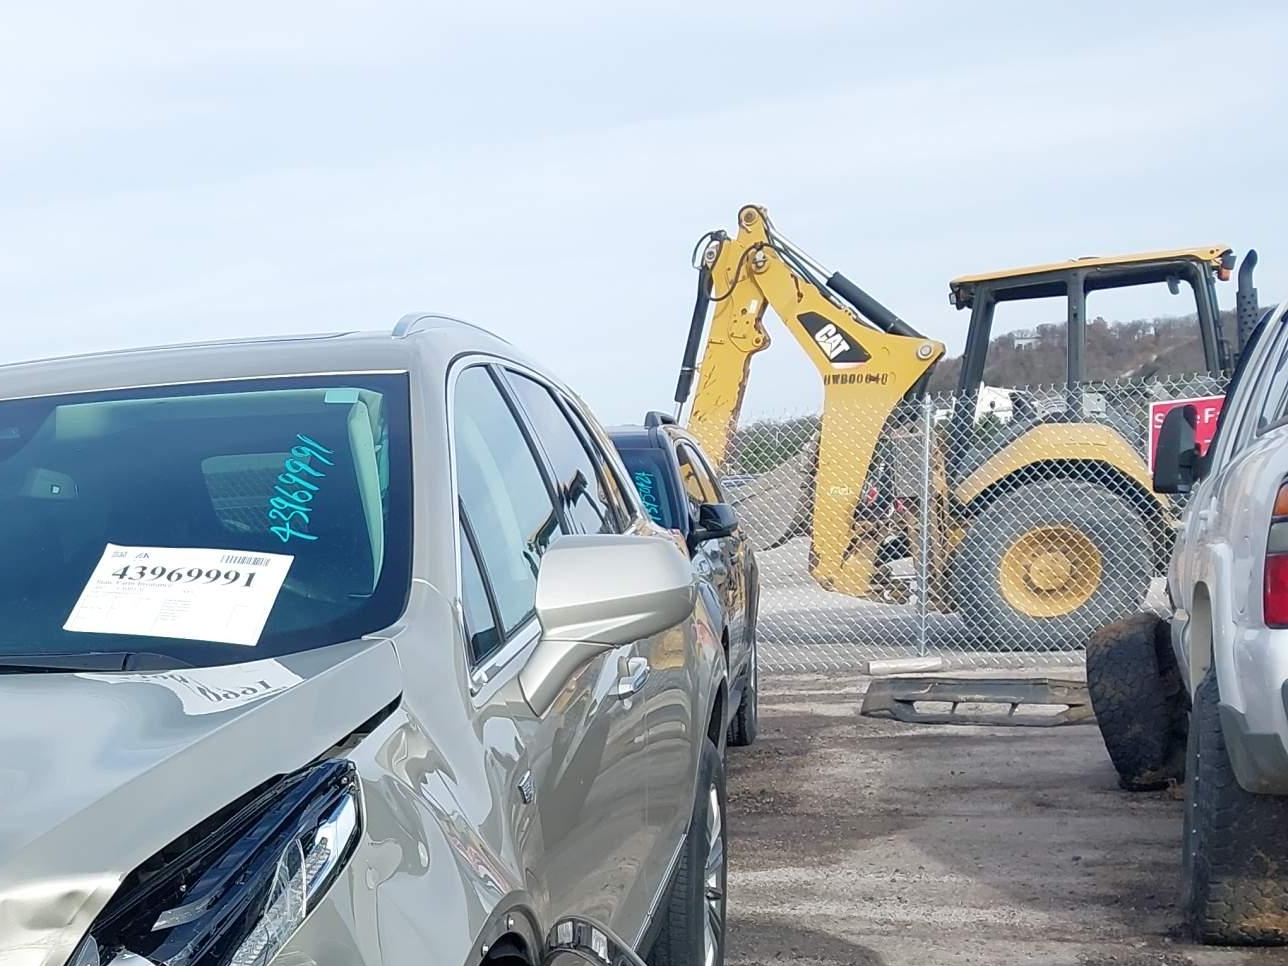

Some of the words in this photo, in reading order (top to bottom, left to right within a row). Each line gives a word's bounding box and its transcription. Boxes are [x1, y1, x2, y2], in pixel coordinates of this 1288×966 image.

[815, 323, 850, 360] CAT
[268, 433, 336, 543] 43969991
[111, 564, 257, 588] 43969991
